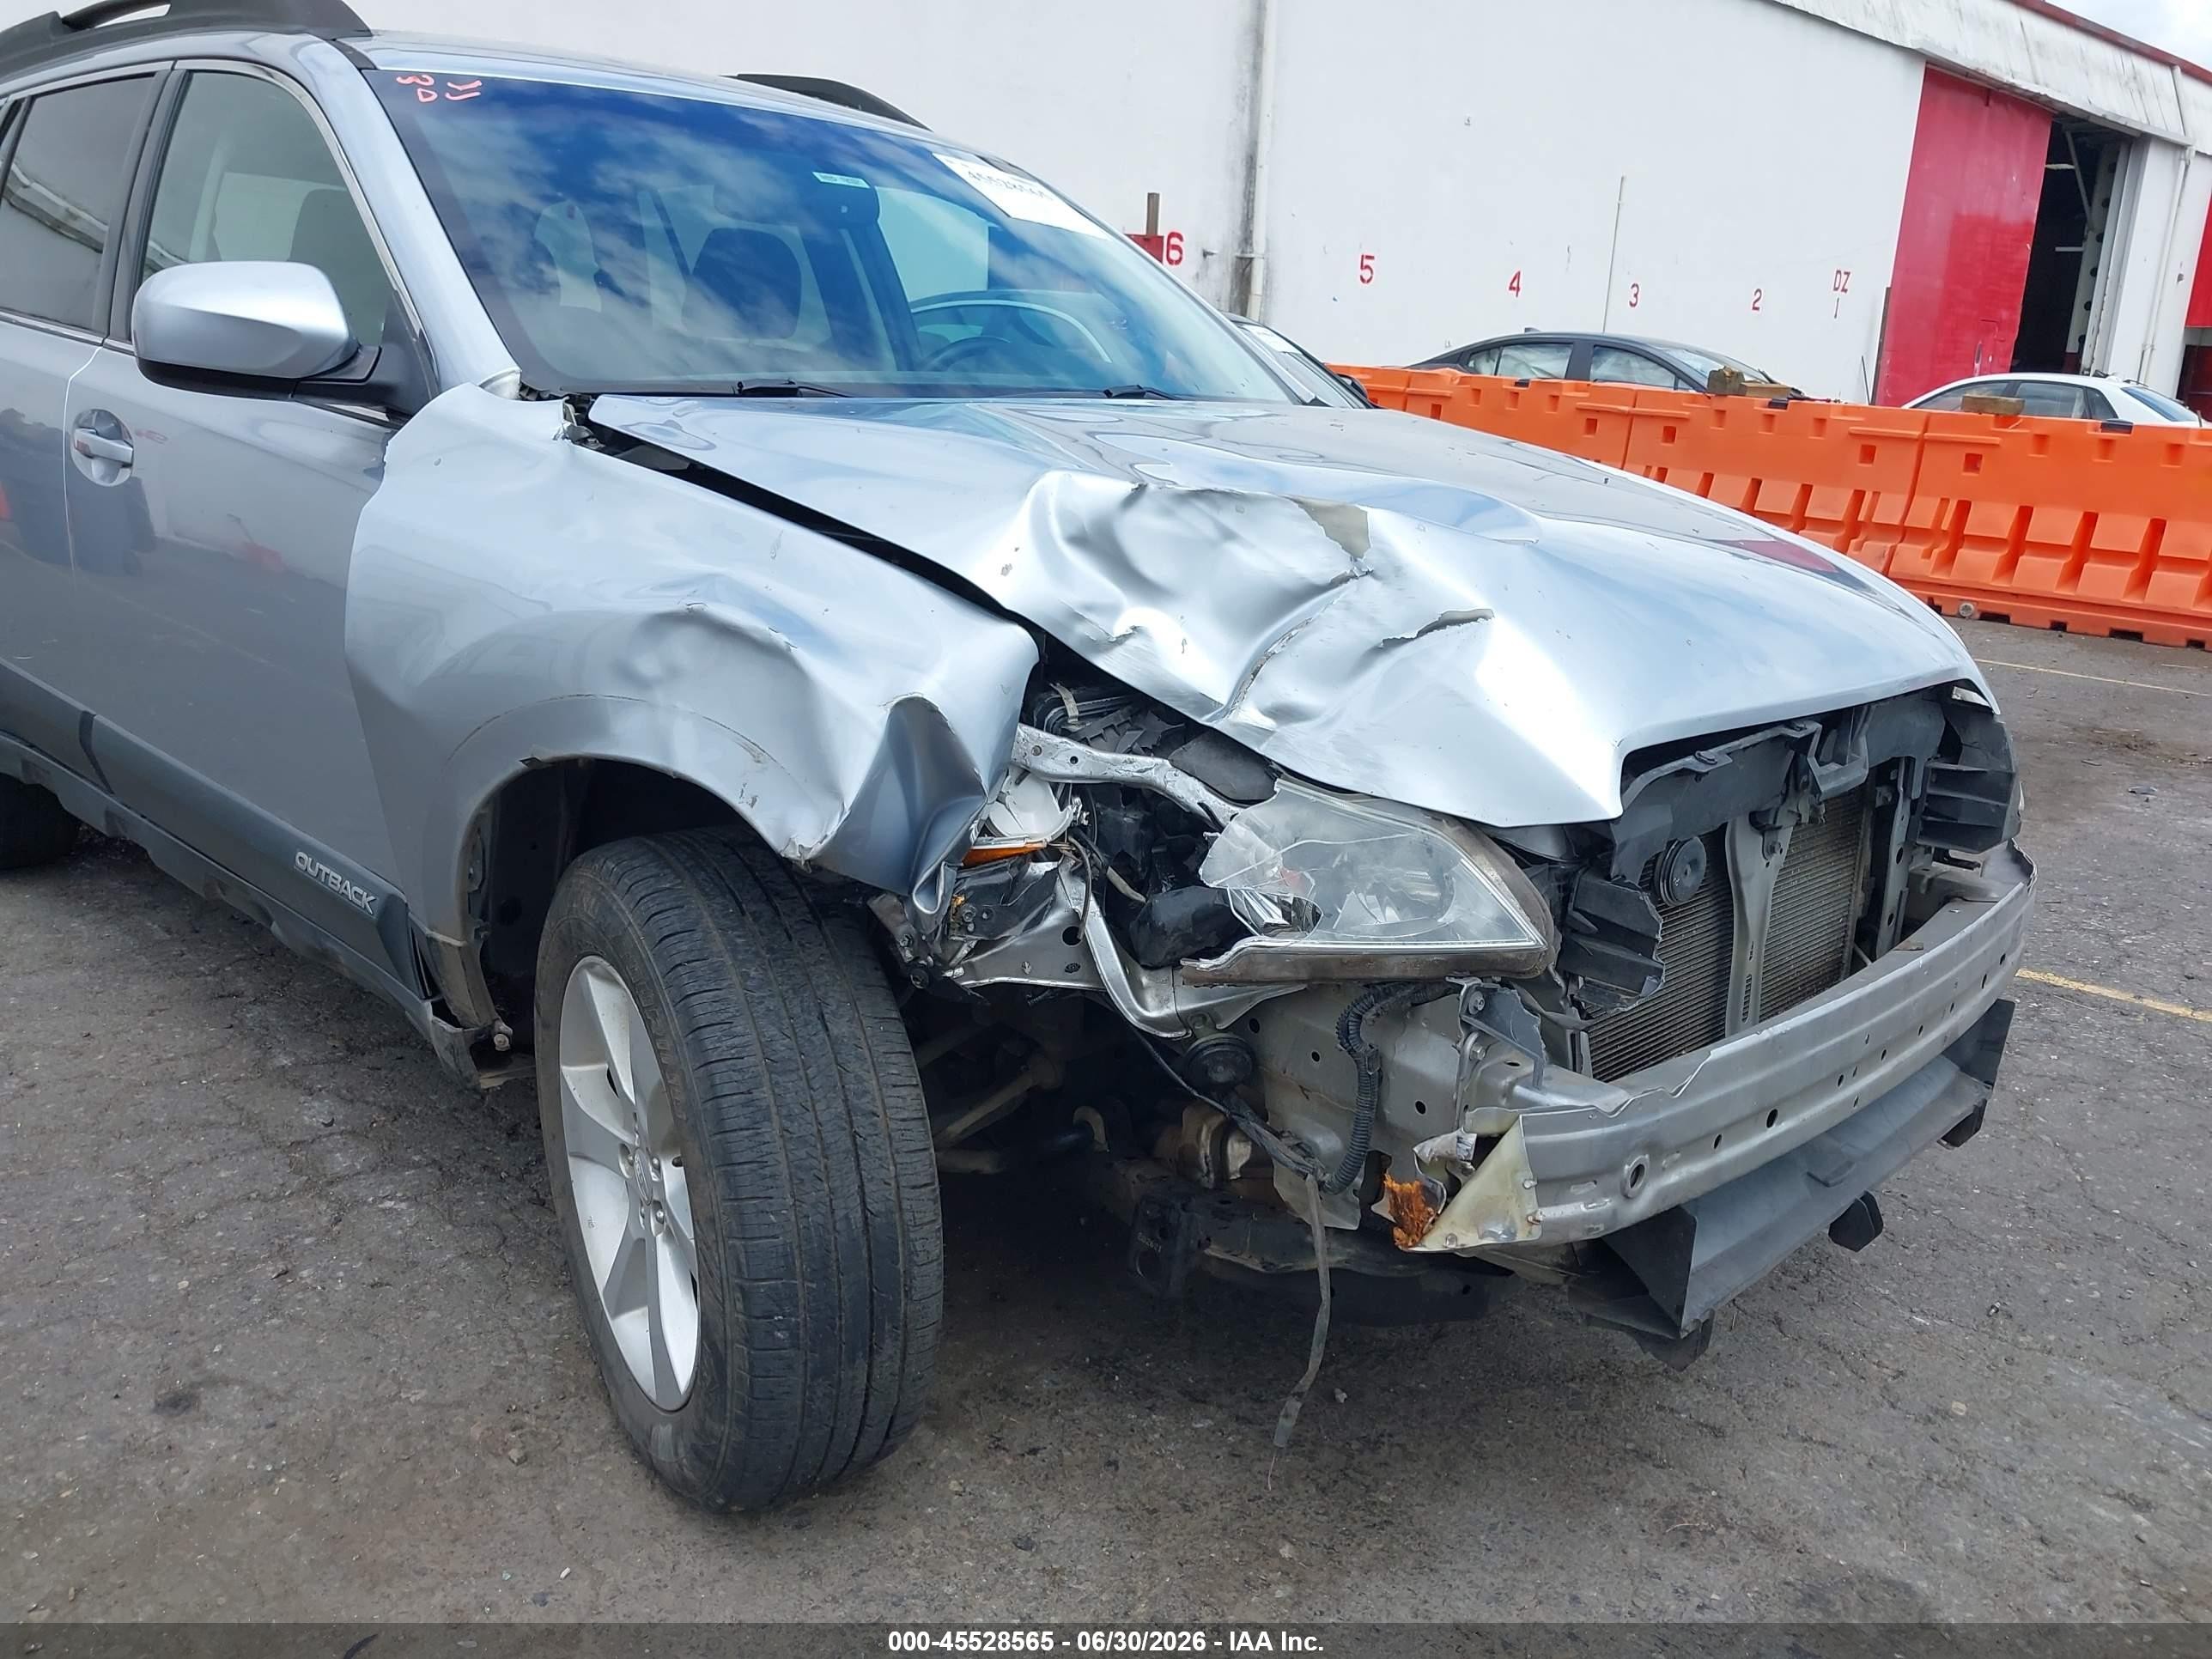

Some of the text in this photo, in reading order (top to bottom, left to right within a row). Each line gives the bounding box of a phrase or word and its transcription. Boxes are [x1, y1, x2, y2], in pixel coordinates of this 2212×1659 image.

[1165, 230, 1184, 267] 6
[1359, 253, 1375, 285] 5
[1832, 269, 1851, 295] DZ
[1508, 270, 1522, 298] 4
[1628, 283, 1640, 308] 3
[1751, 288, 1763, 312] 2
[295, 851, 376, 915] OUTBACK
